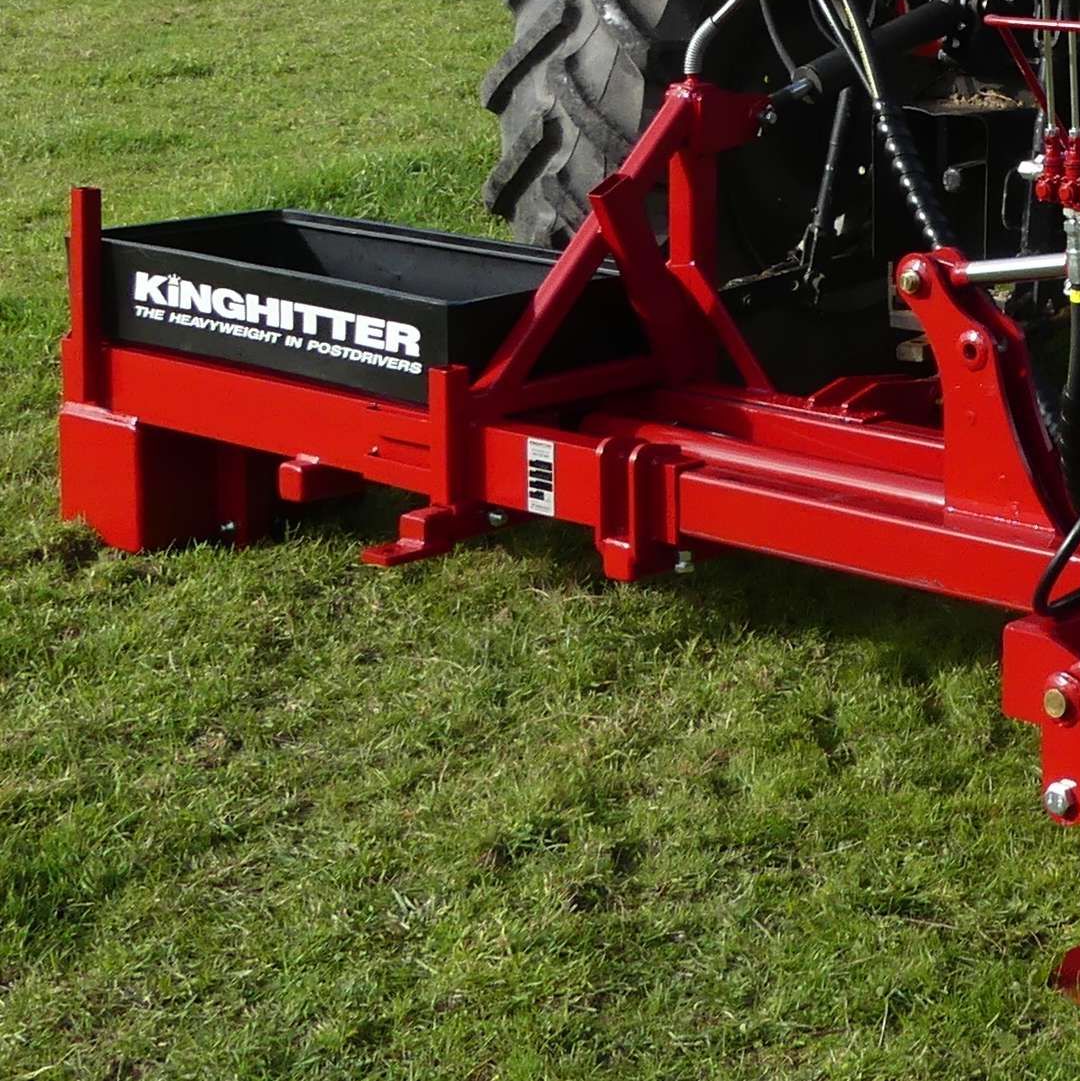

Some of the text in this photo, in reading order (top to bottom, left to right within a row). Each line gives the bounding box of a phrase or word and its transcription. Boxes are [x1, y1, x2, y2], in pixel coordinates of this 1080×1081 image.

[134, 305, 424, 375] THE HEAVYWEIGHT IN POSTDRIVERS
